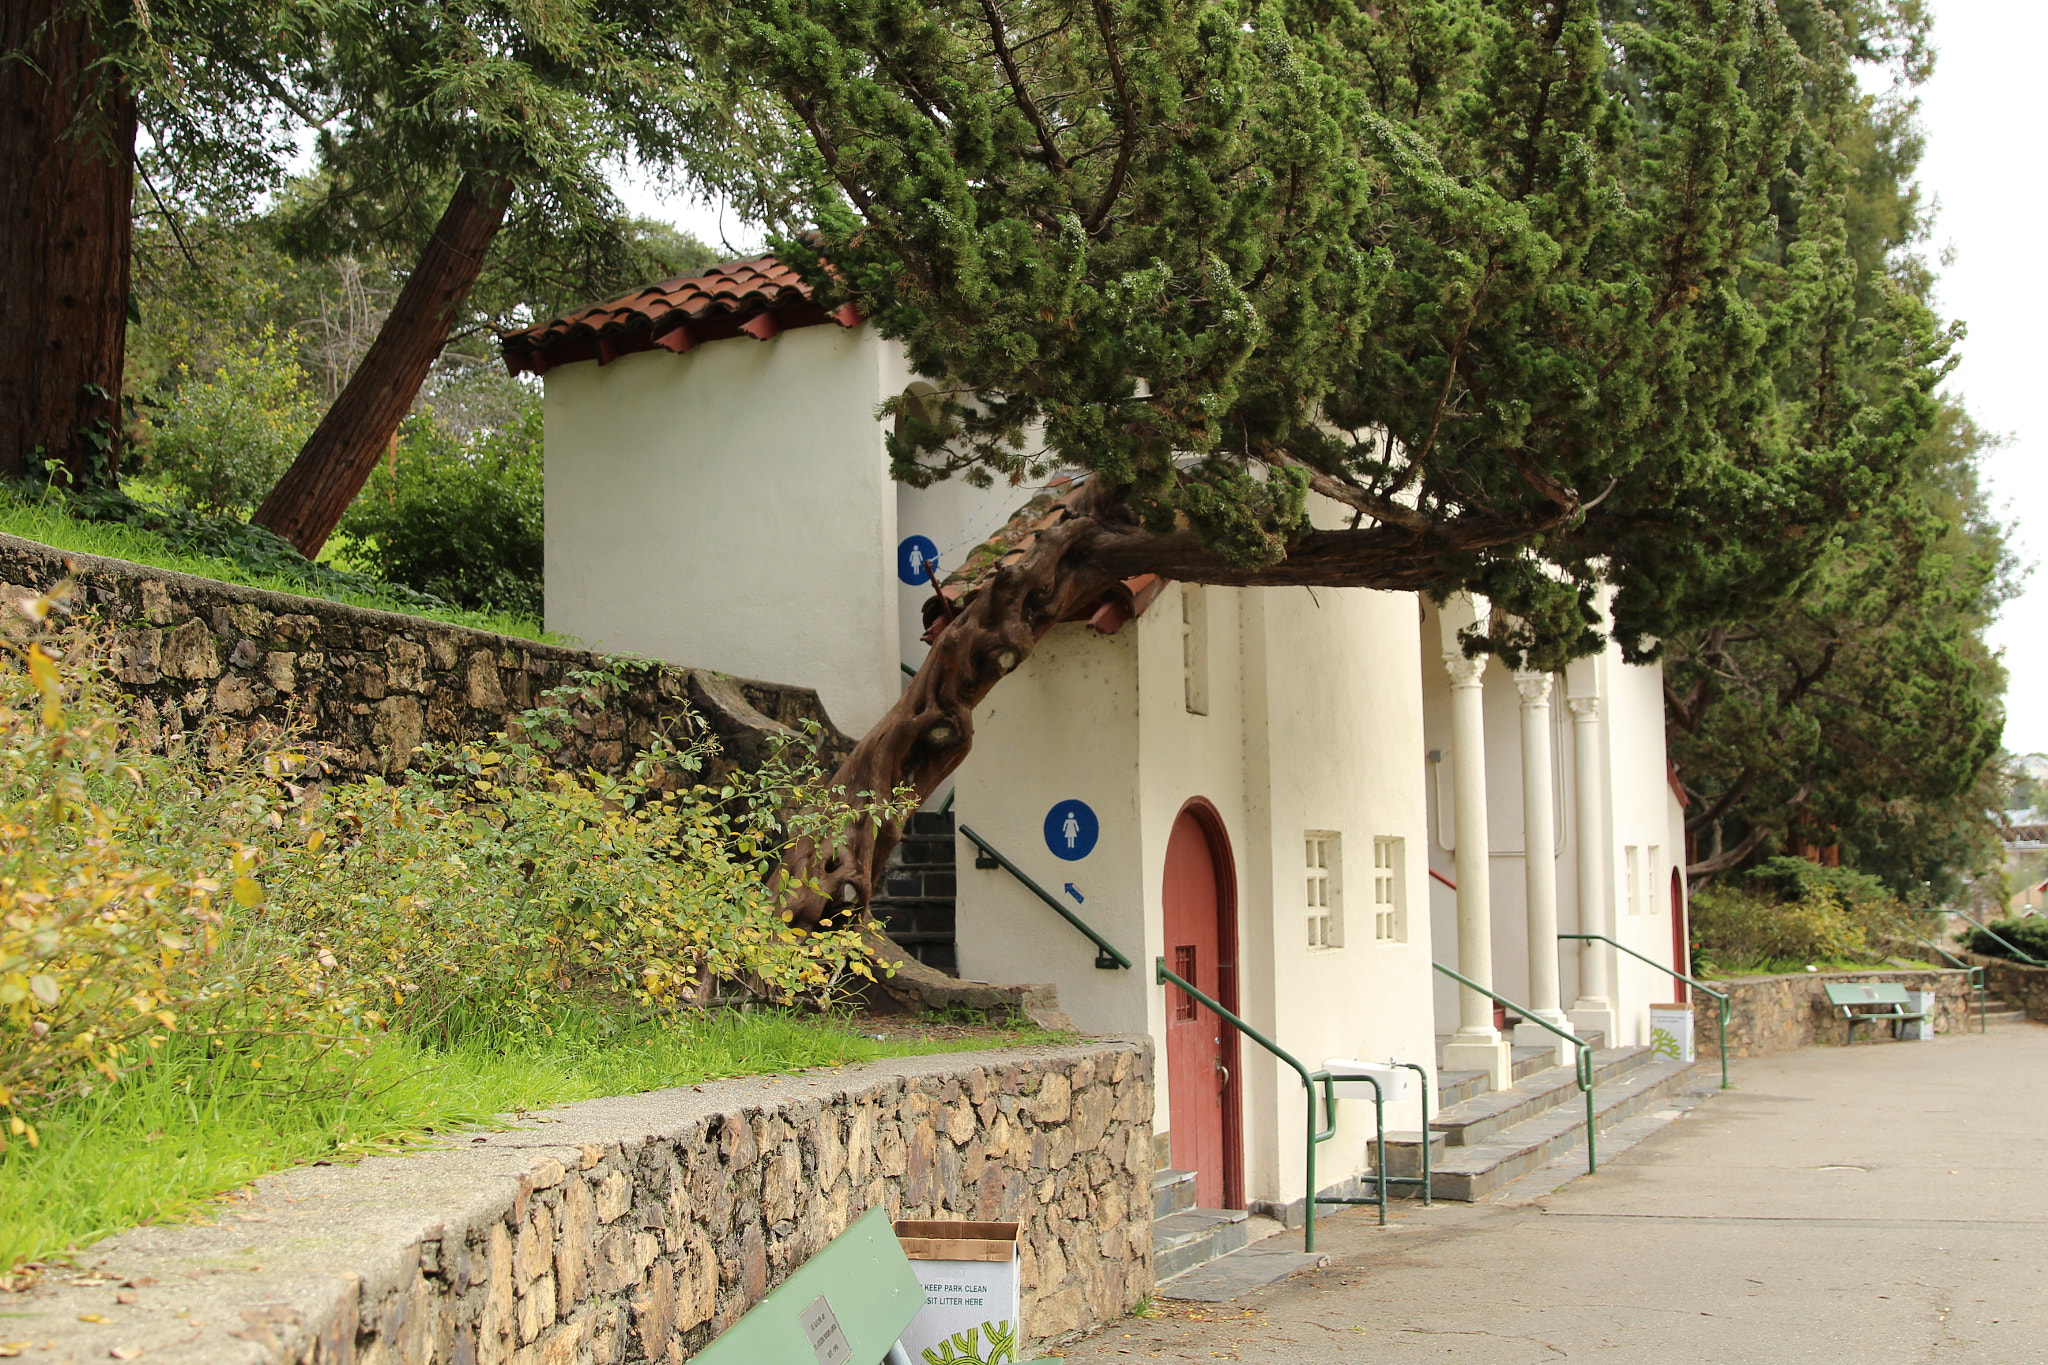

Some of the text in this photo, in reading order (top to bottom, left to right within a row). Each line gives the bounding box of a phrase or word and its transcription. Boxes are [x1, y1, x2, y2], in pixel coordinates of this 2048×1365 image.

[944, 1284, 963, 1292] PARK
[940, 1297, 963, 1305] LITTER
[965, 1298, 983, 1306] HERE
